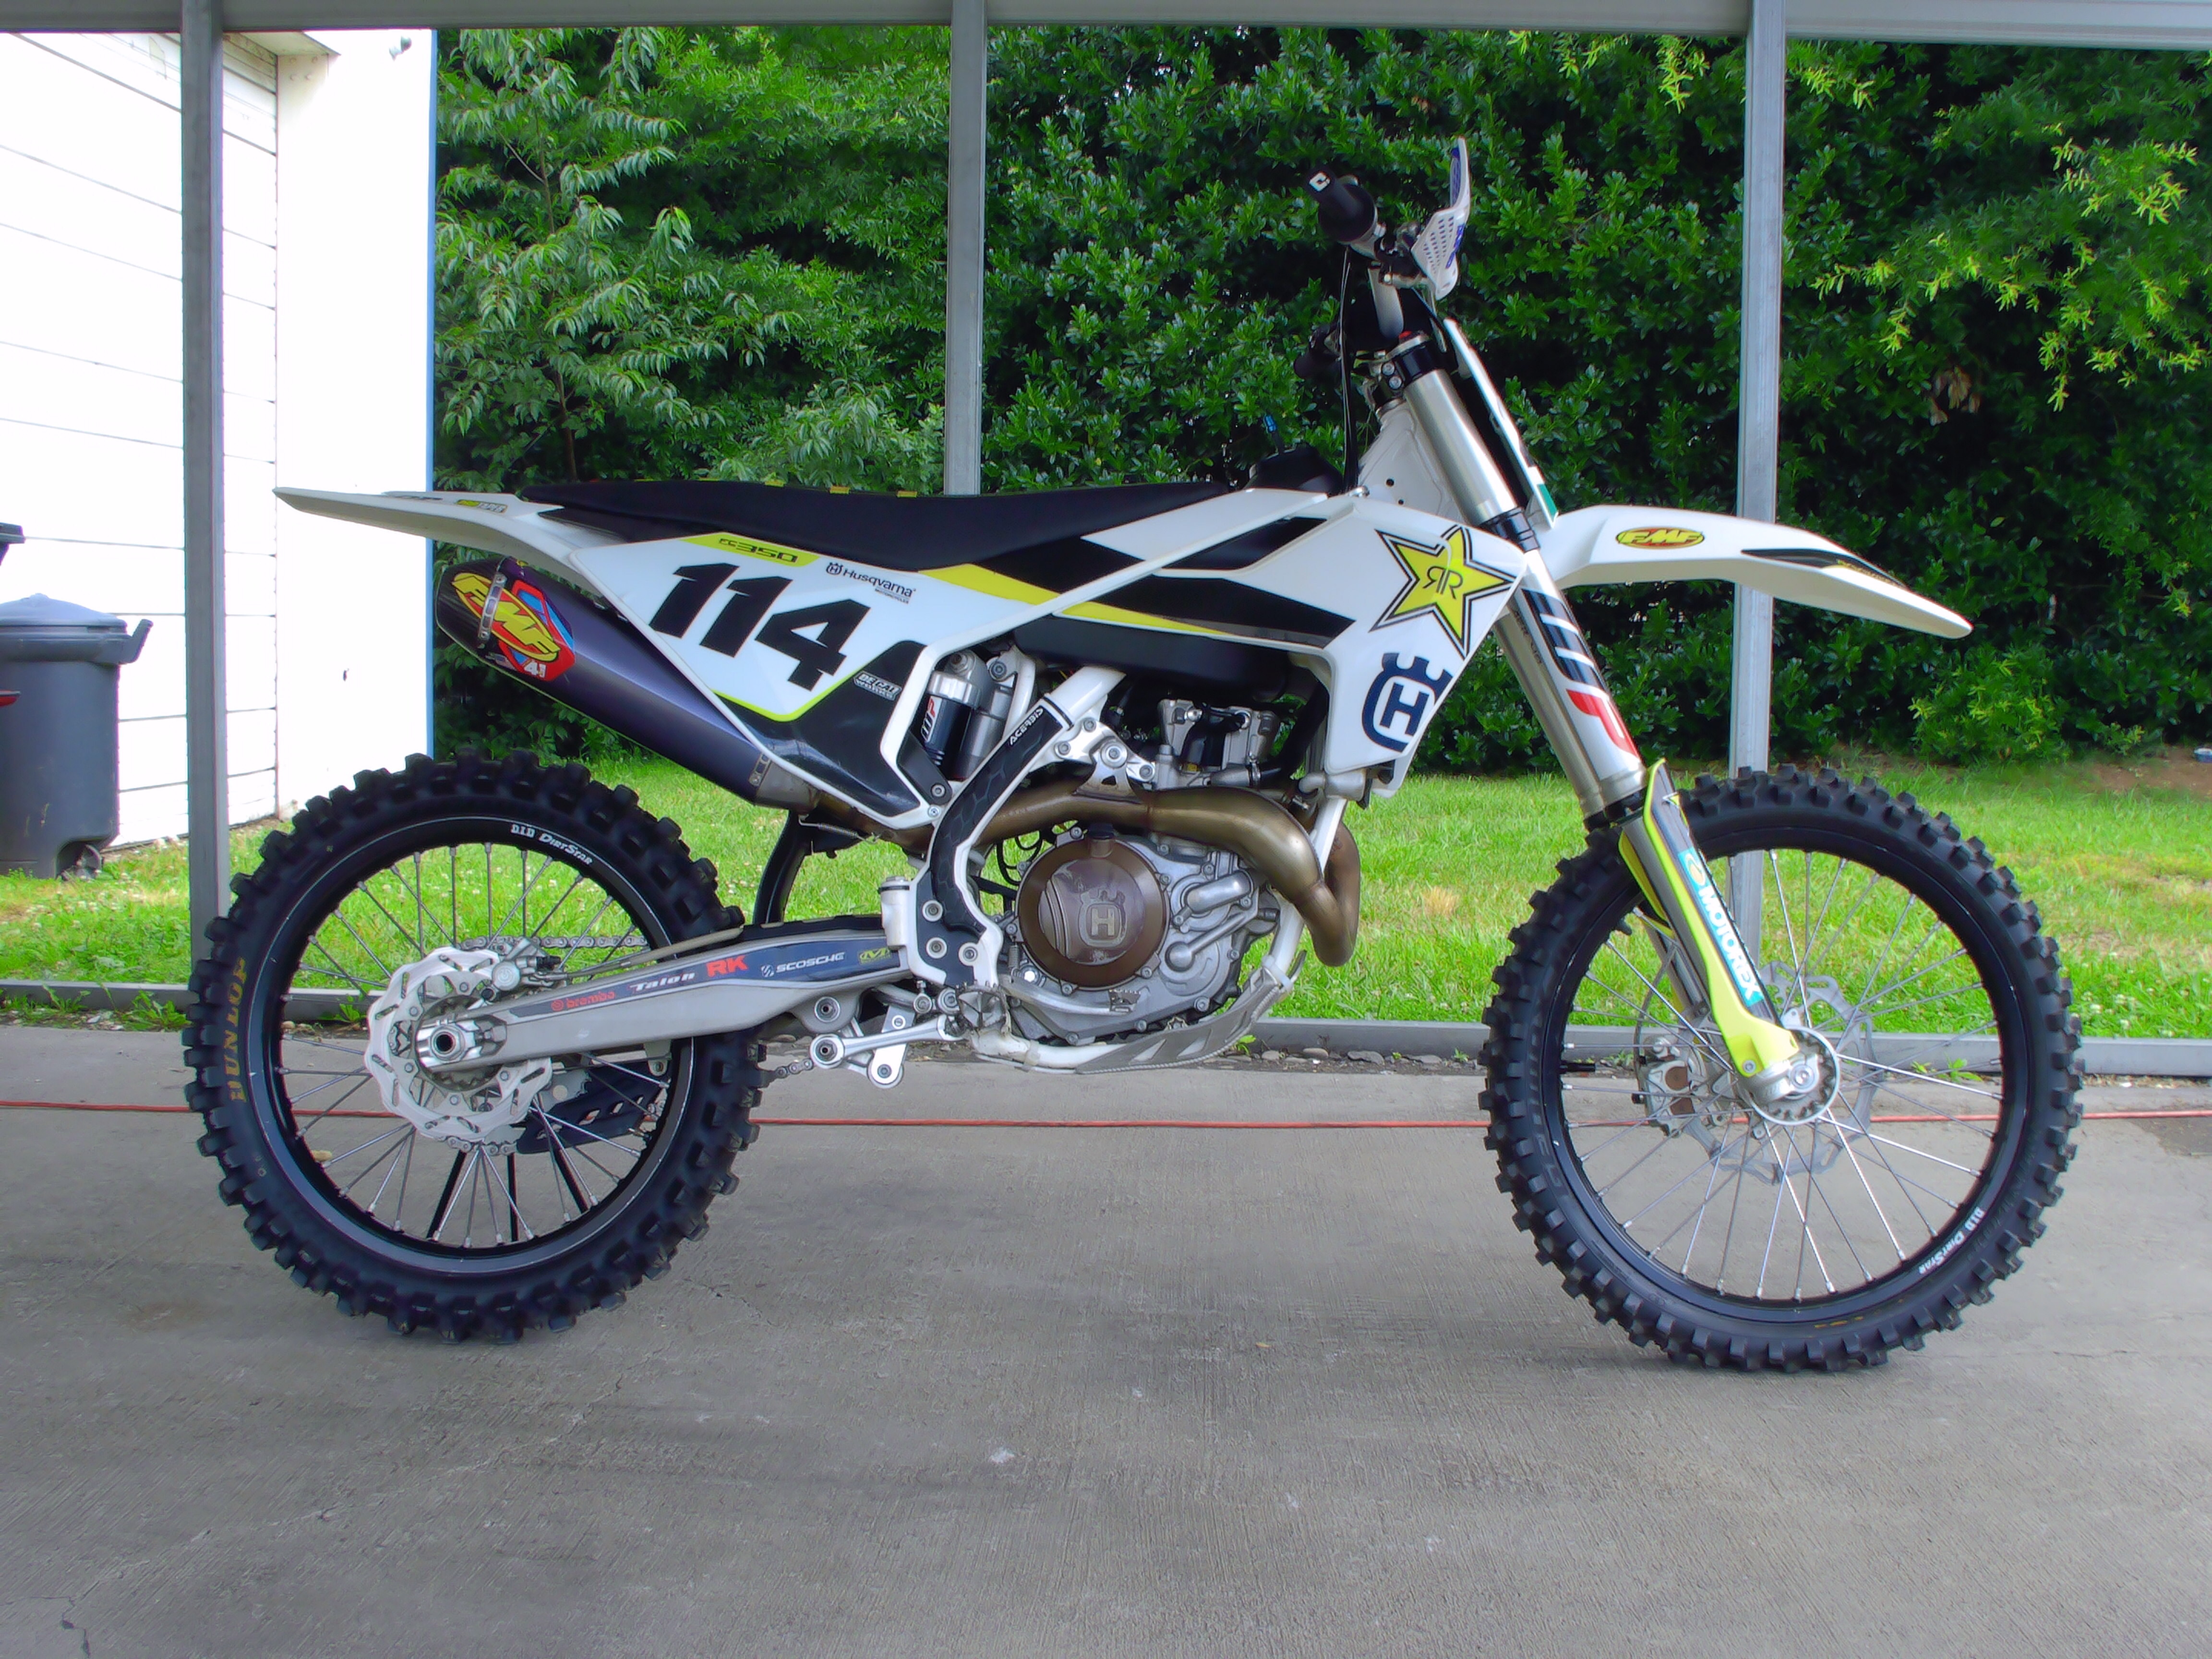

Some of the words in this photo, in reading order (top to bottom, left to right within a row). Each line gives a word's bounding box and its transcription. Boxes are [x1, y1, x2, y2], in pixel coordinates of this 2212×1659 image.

[1619, 529, 1703, 544] FMF
[843, 568, 913, 598] Husqvarna
[649, 562, 871, 692] 114
[1009, 707, 1044, 745] ACERBIS
[1698, 885, 1764, 1000] MOTOREX
[706, 955, 748, 978] RK
[776, 952, 845, 974] SCOSCHE
[628, 971, 695, 991] Talon
